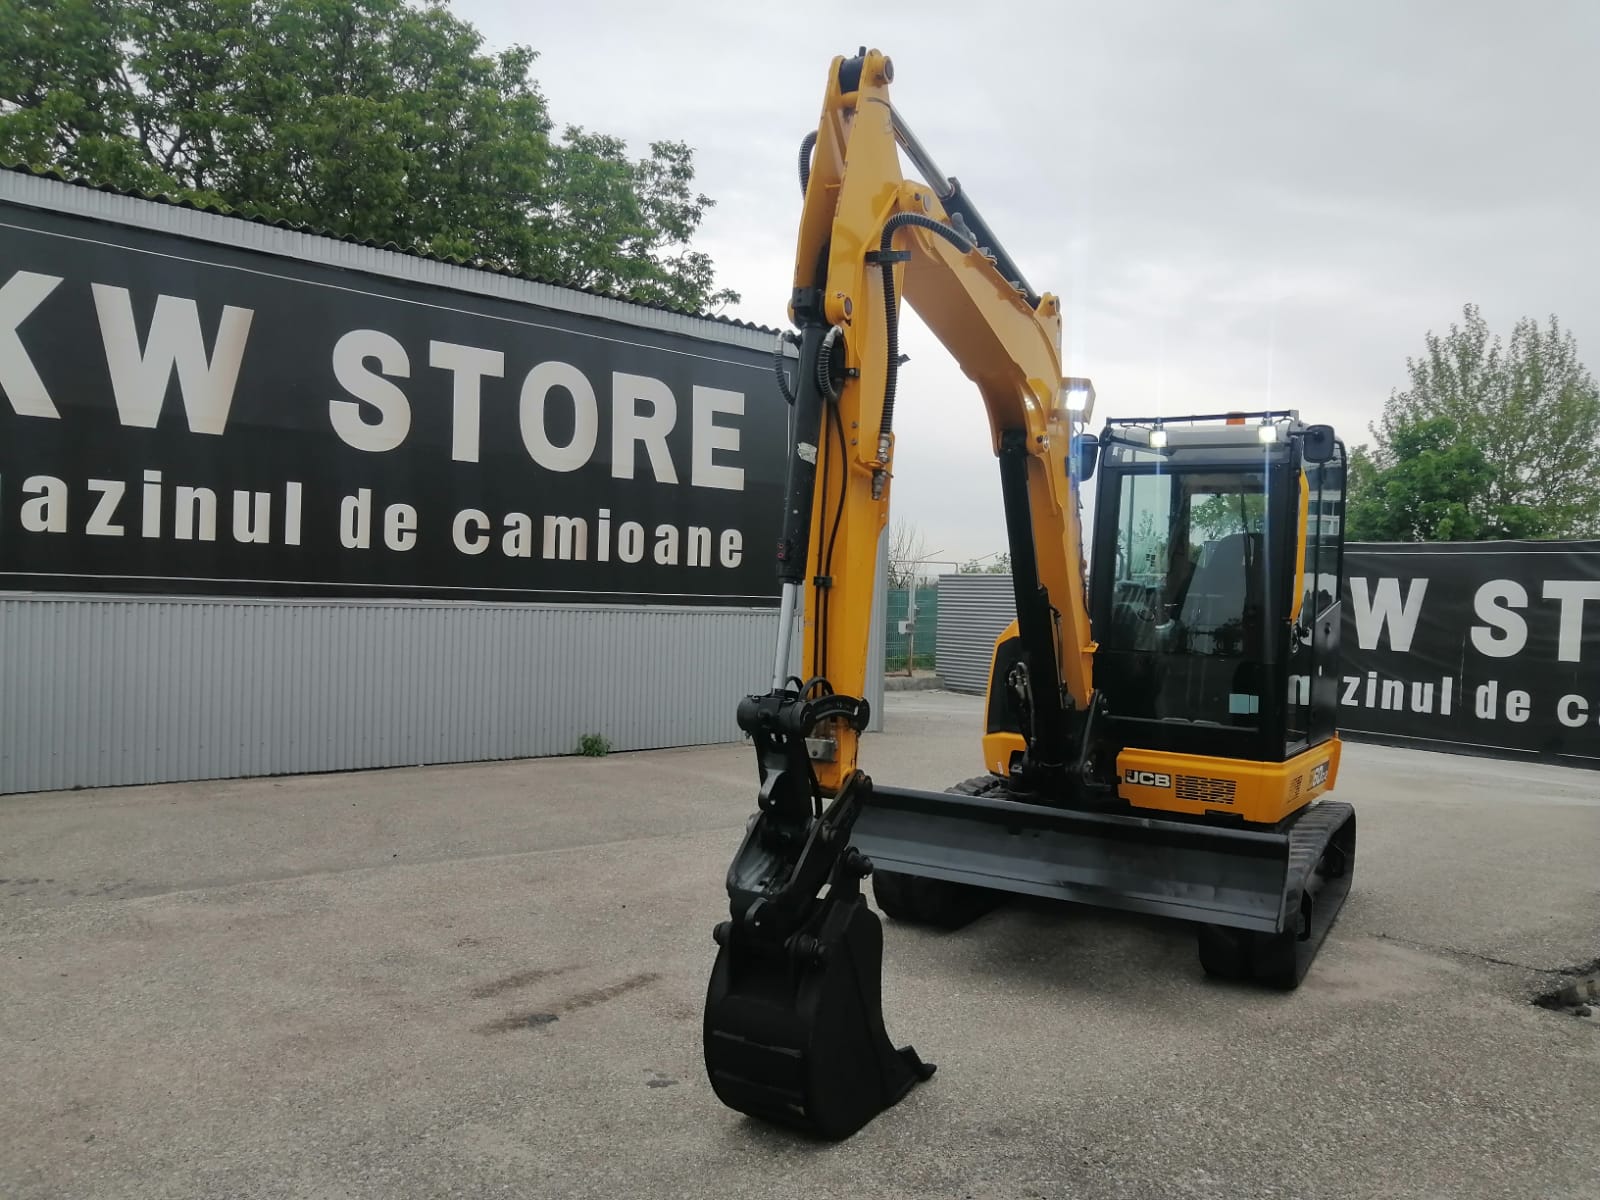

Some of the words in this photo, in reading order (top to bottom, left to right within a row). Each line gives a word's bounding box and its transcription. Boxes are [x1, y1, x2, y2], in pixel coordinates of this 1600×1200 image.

[329, 329, 745, 491] STORE
[340, 488, 417, 551] de
[453, 509, 742, 568] camioane
[1476, 681, 1530, 722] de
[1558, 694, 1600, 731] c
[1126, 771, 1170, 787] JCB
